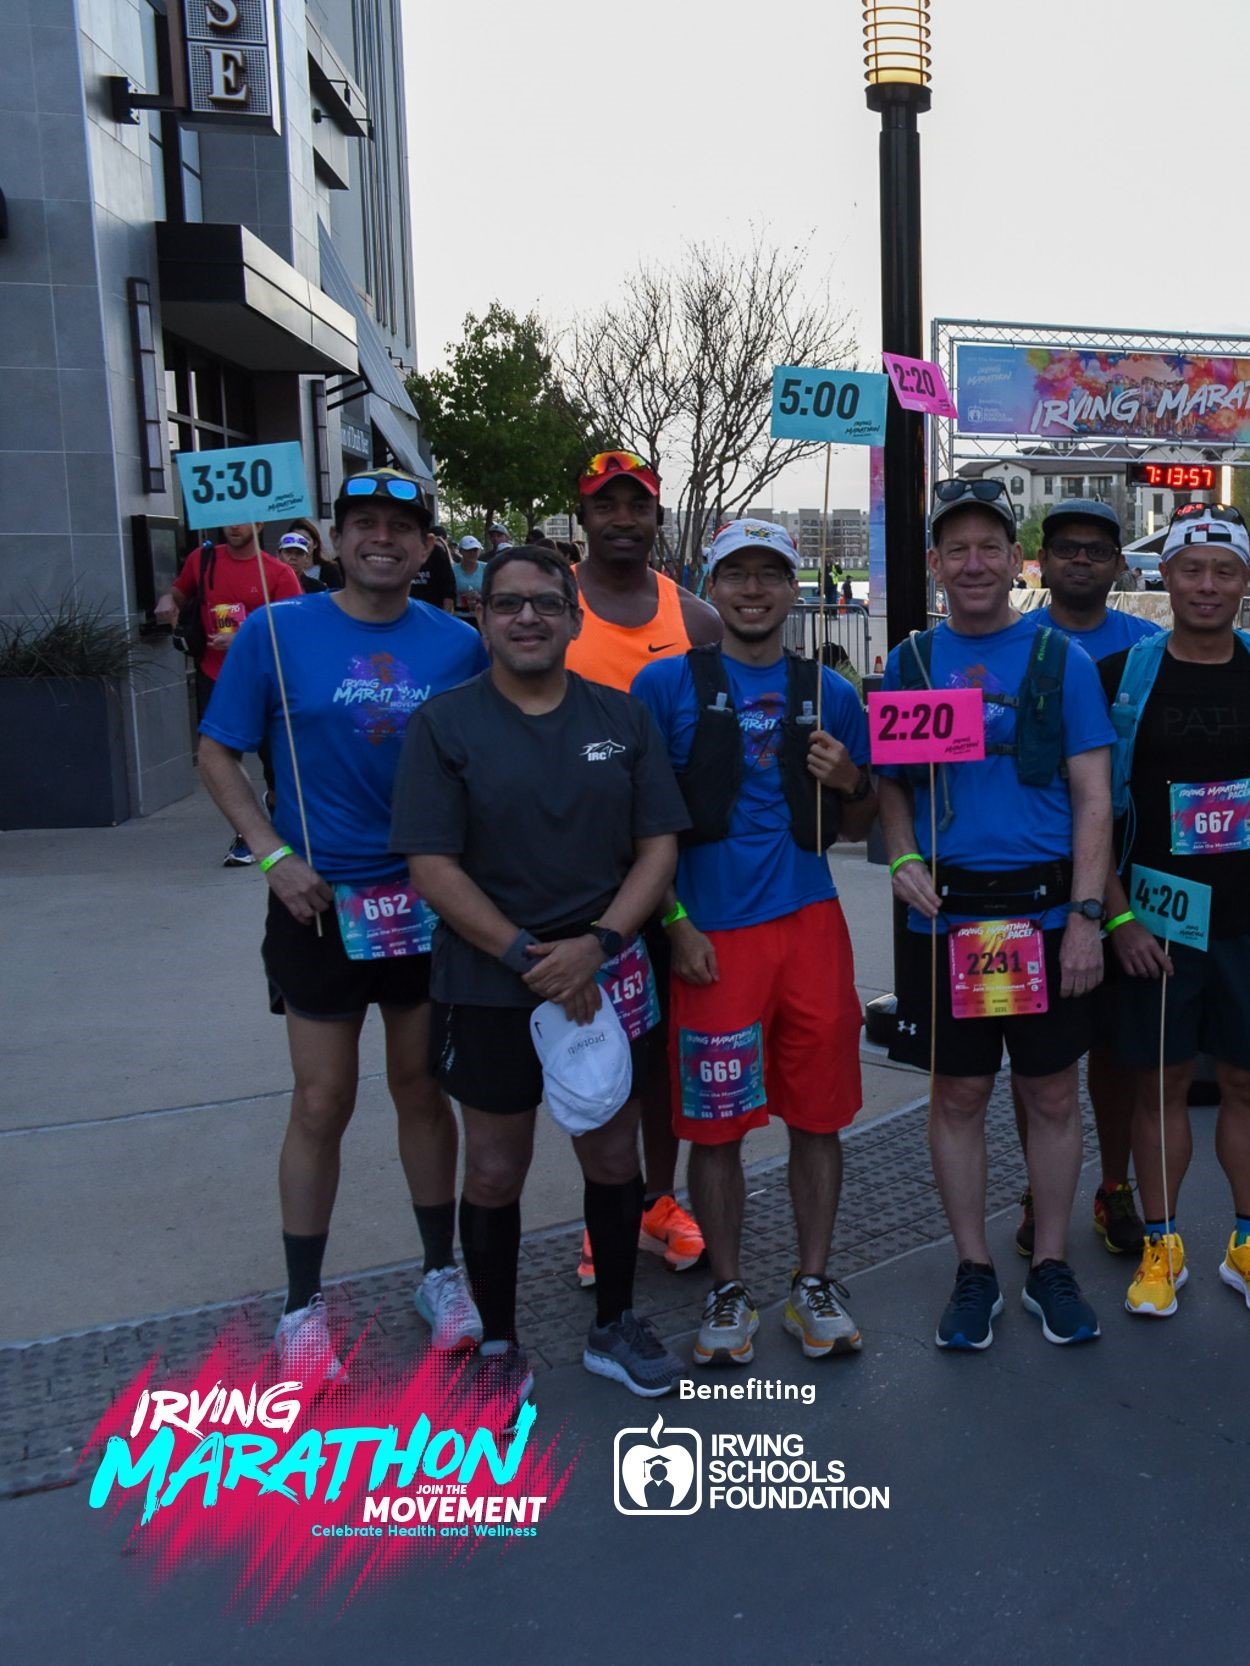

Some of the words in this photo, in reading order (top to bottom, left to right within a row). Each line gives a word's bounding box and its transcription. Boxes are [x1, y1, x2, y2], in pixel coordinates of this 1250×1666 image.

[892, 363, 936, 398] 2:20
[779, 378, 860, 419] 5:00
[1030, 387, 1141, 433] IRVING
[192, 458, 272, 504] 3:30
[878, 703, 954, 741] 2:20
[588, 752, 607, 761] IRC
[1194, 809, 1235, 834] 667
[363, 894, 411, 920] 662
[1135, 878, 1189, 922] 4:20
[966, 950, 1022, 976] 2231
[700, 1059, 742, 1082] 669
